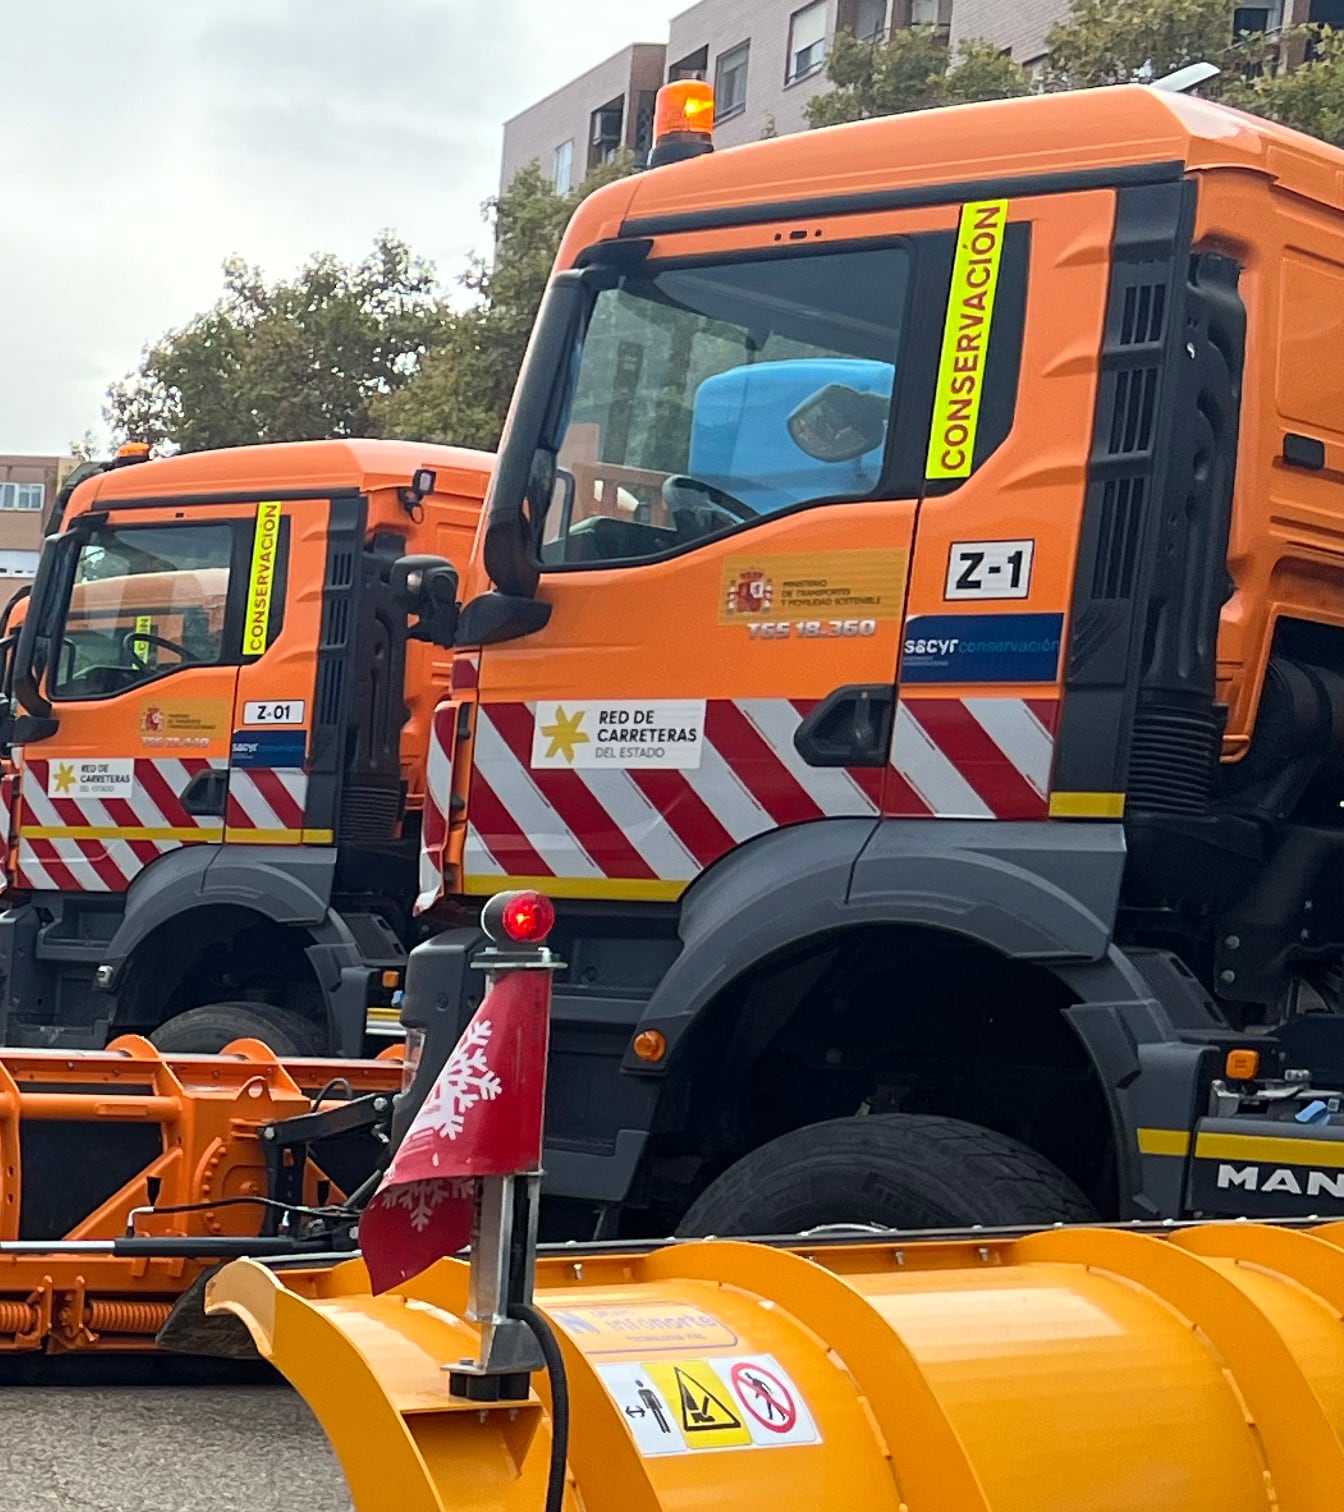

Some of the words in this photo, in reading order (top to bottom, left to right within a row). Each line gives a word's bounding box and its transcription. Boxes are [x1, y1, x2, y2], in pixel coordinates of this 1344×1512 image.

[940, 205, 1001, 471] CONSERVACIÓN
[955, 550, 1024, 590] Z-1
[795, 619, 877, 638] 18.360
[257, 705, 291, 720] Z-01
[598, 710, 630, 725] RED
[633, 710, 655, 725] DE
[596, 728, 698, 743] CARRETERAS
[595, 746, 617, 759] DEL
[619, 746, 666, 759] ESTADO
[1216, 1163, 1344, 1198] MAN
